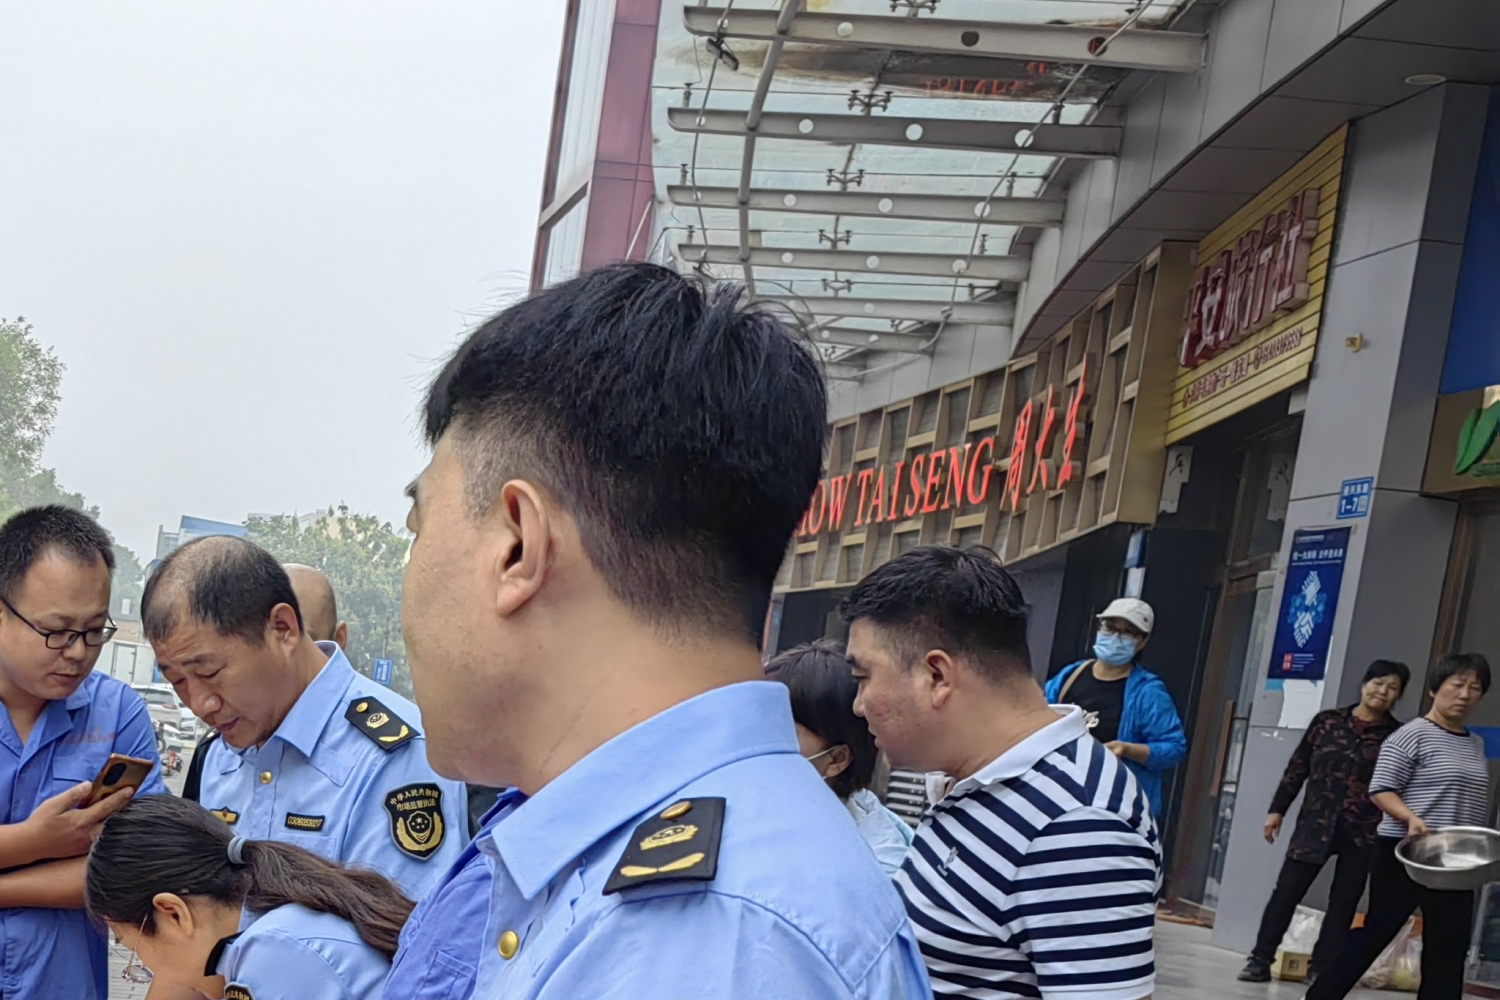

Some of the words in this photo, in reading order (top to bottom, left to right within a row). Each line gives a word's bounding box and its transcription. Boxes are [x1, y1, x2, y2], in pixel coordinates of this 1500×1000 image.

[854, 461, 904, 526] TAI
[904, 437, 995, 517] SENG
[389, 788, 439, 805] 中华人民共和国
